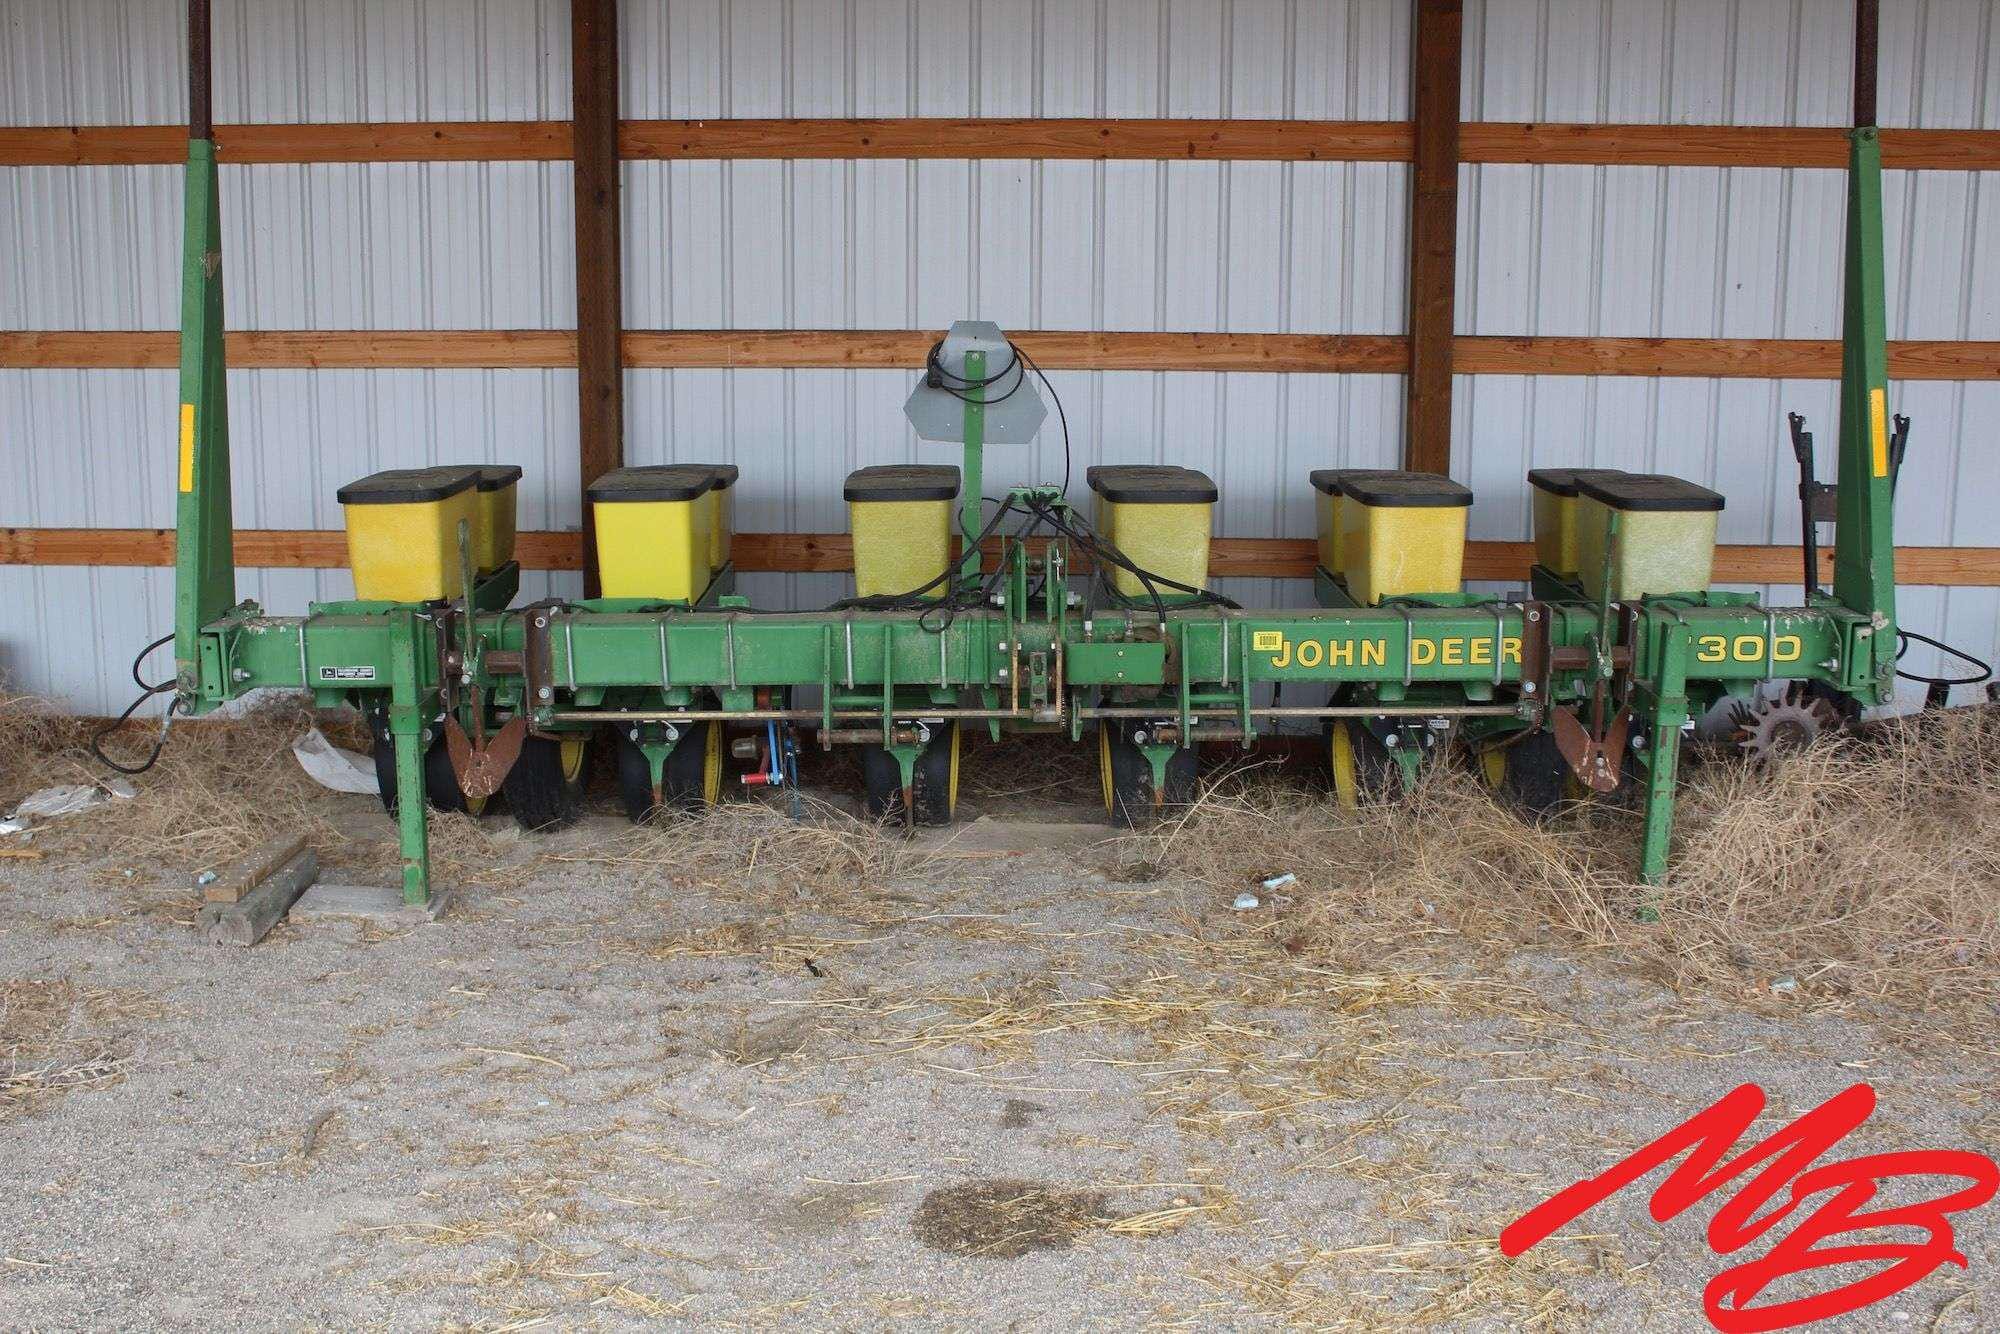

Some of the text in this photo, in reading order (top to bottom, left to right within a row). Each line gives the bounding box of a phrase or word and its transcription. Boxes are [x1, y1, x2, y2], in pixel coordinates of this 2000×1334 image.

[1271, 637, 1523, 668] JOHN DEER
[1691, 634, 1802, 662] 300
